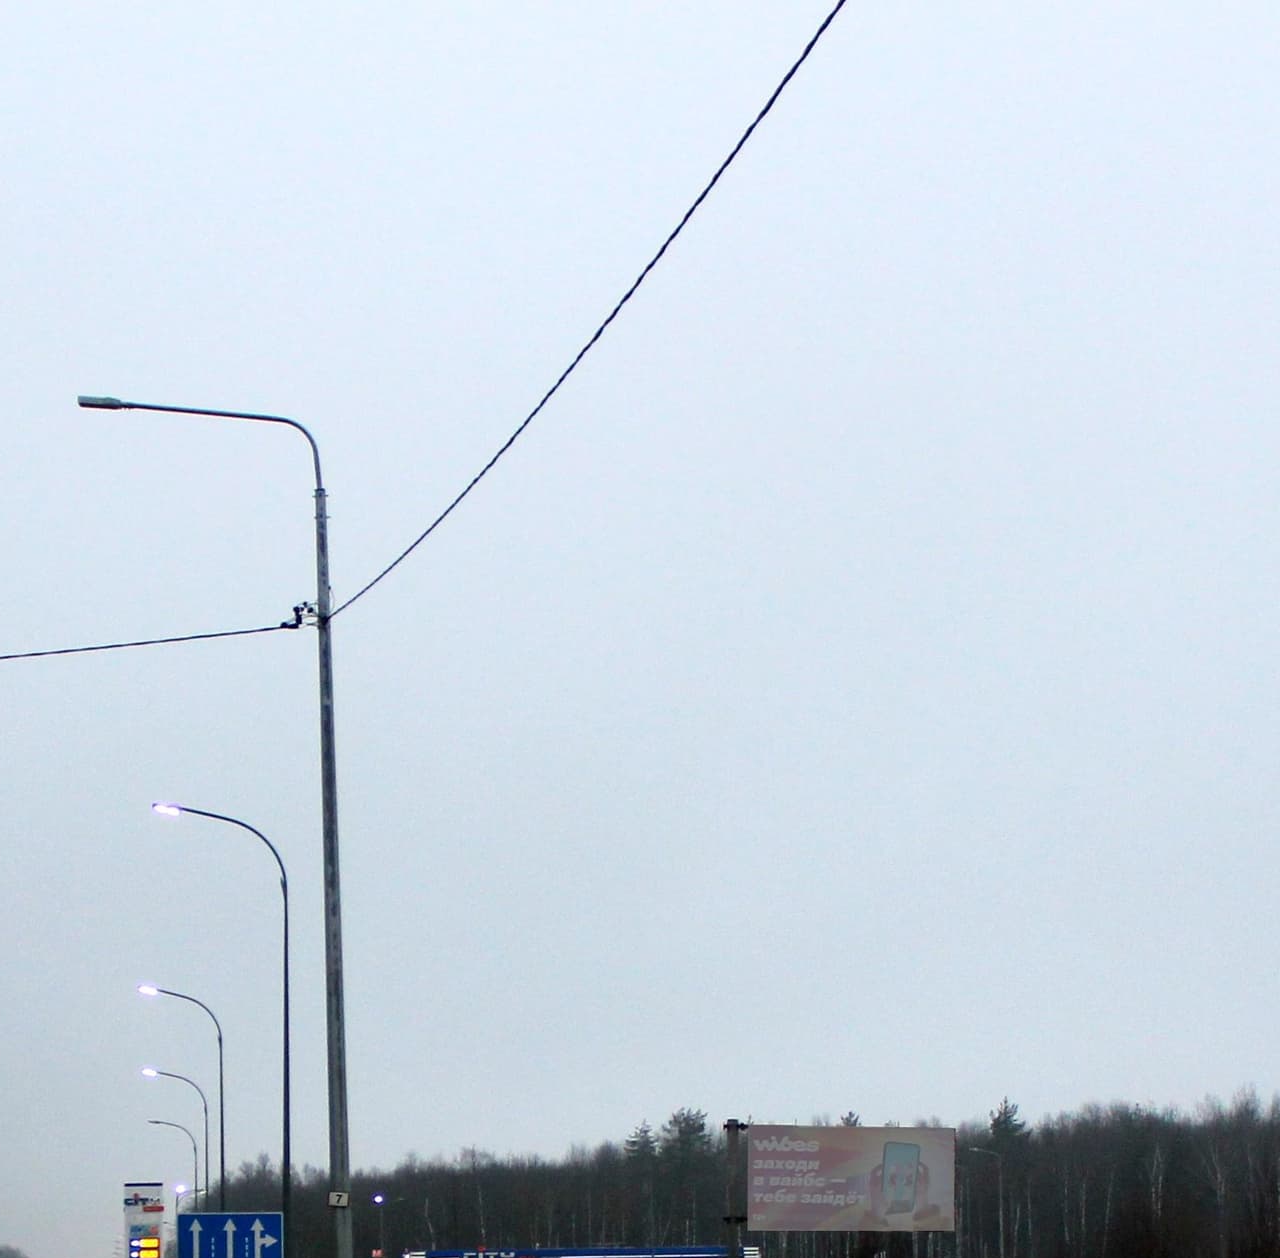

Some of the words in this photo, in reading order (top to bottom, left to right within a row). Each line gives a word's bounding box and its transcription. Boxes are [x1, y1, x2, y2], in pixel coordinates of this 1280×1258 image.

[753, 1135, 820, 1152] wibes
[753, 1159, 821, 1171] заходи
[753, 1176, 765, 1186] в
[769, 1172, 826, 1187] вайбс
[335, 1194, 343, 1204] 7
[753, 1188, 796, 1203] тебе
[800, 1190, 867, 1207] зайдёт
